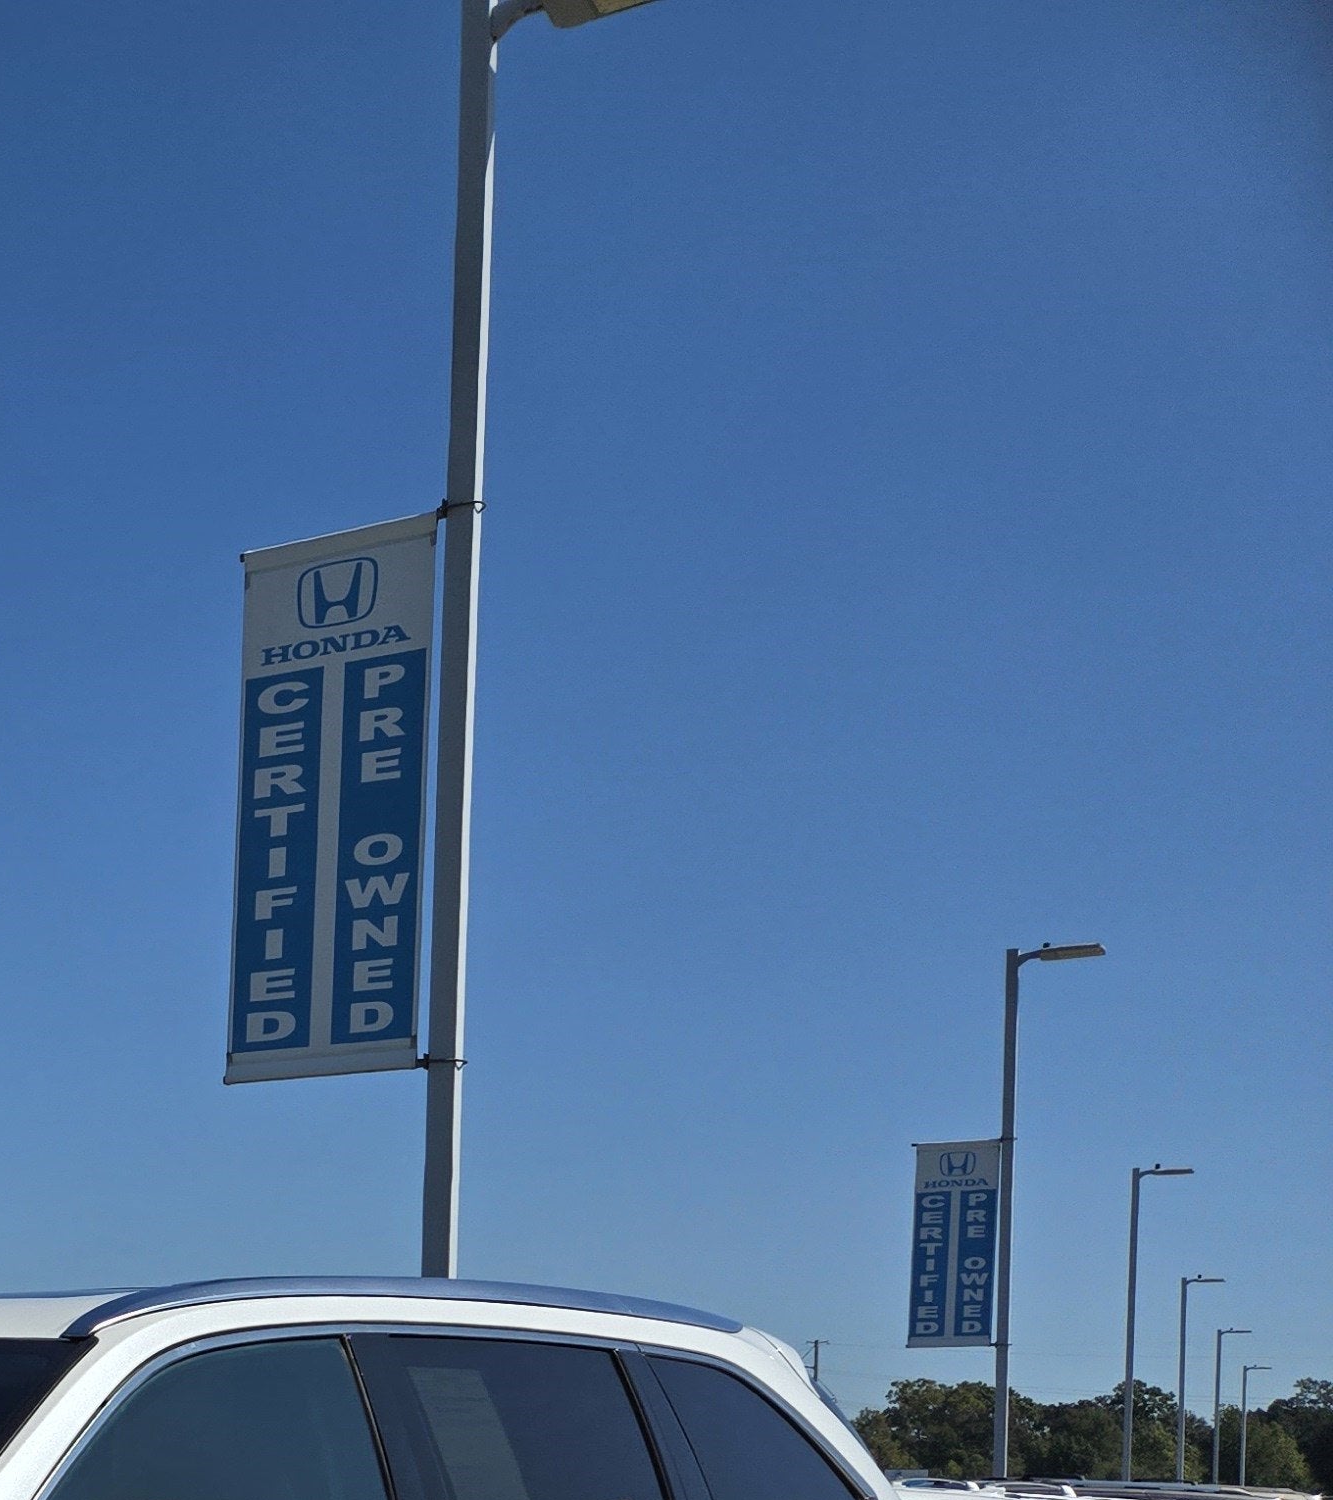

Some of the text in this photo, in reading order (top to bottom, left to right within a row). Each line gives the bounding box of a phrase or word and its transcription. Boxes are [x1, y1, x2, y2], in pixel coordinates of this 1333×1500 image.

[260, 624, 411, 667] HONDA
[246, 682, 309, 1043] CERTIFIED
[344, 664, 410, 1034] PRE OWNED
[924, 1178, 989, 1189] HONDA
[915, 1195, 945, 1335] CERTIFIED
[960, 1192, 989, 1334] PRE OWNED
